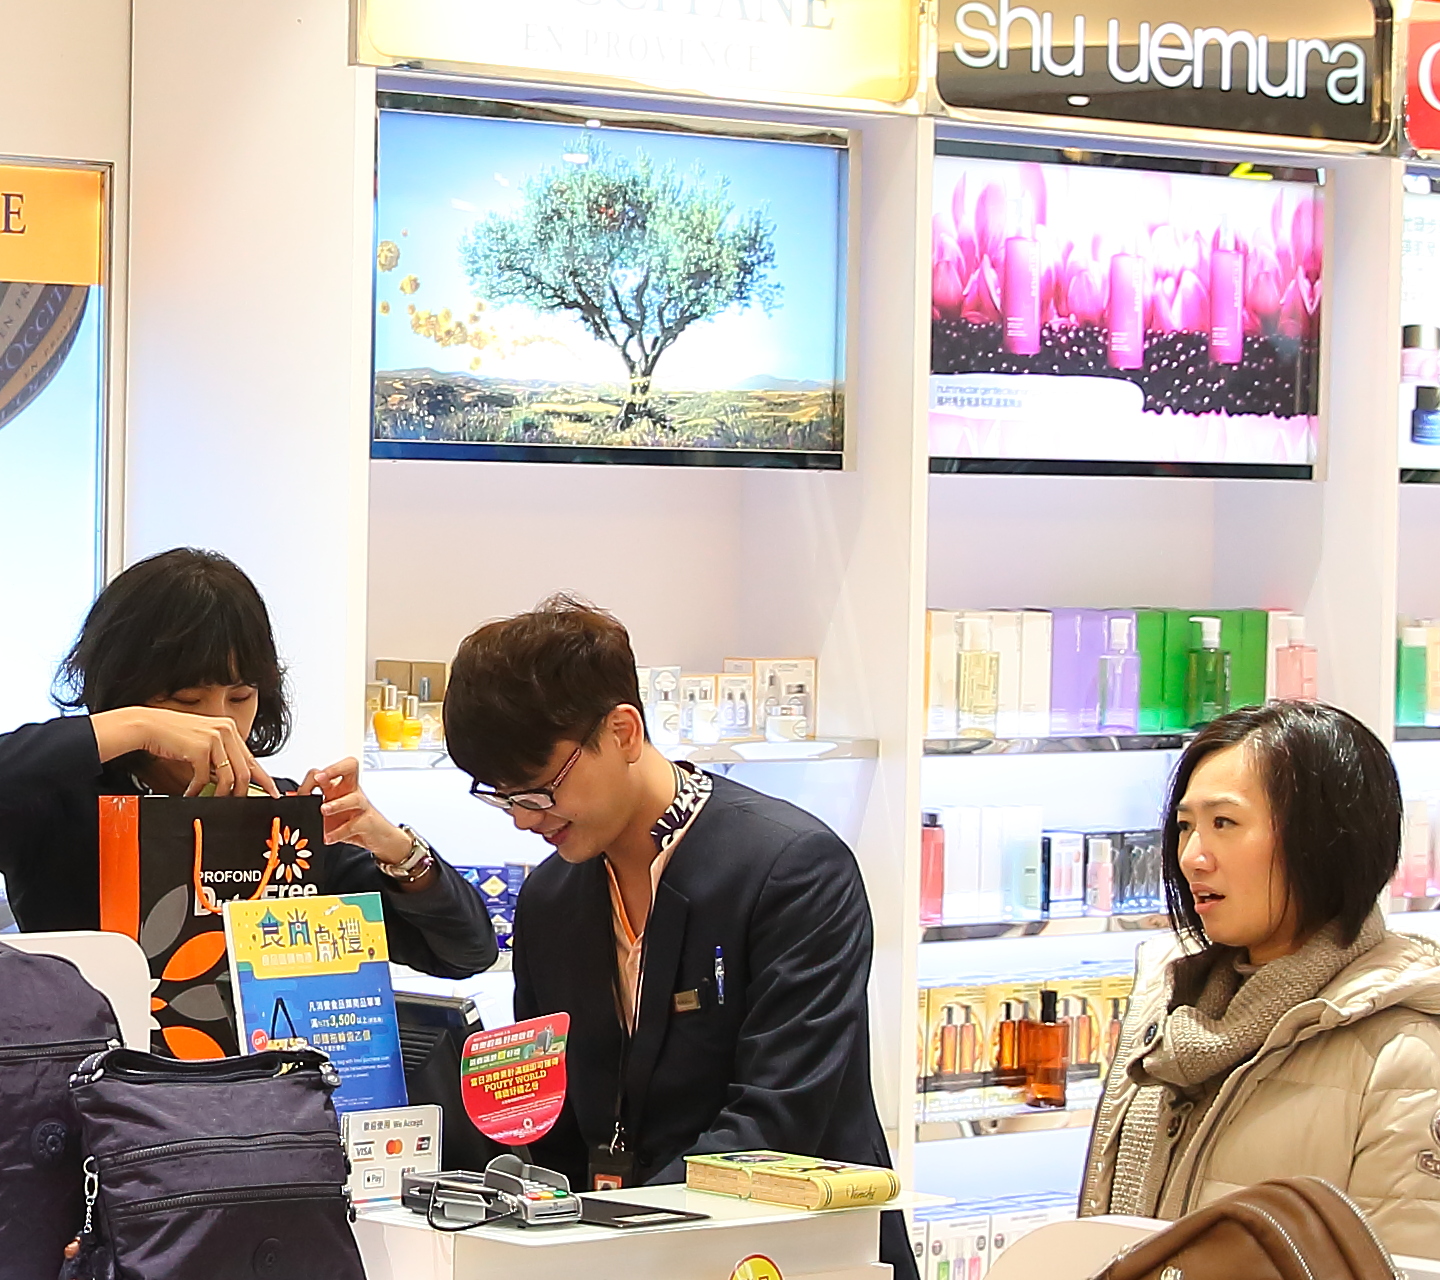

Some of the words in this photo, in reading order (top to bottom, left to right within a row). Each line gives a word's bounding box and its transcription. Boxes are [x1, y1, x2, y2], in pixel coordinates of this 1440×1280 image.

[1108, 18, 1367, 106] uemura
[514, 1069, 547, 1083] WORLD
[356, 1146, 372, 1157] VISA
